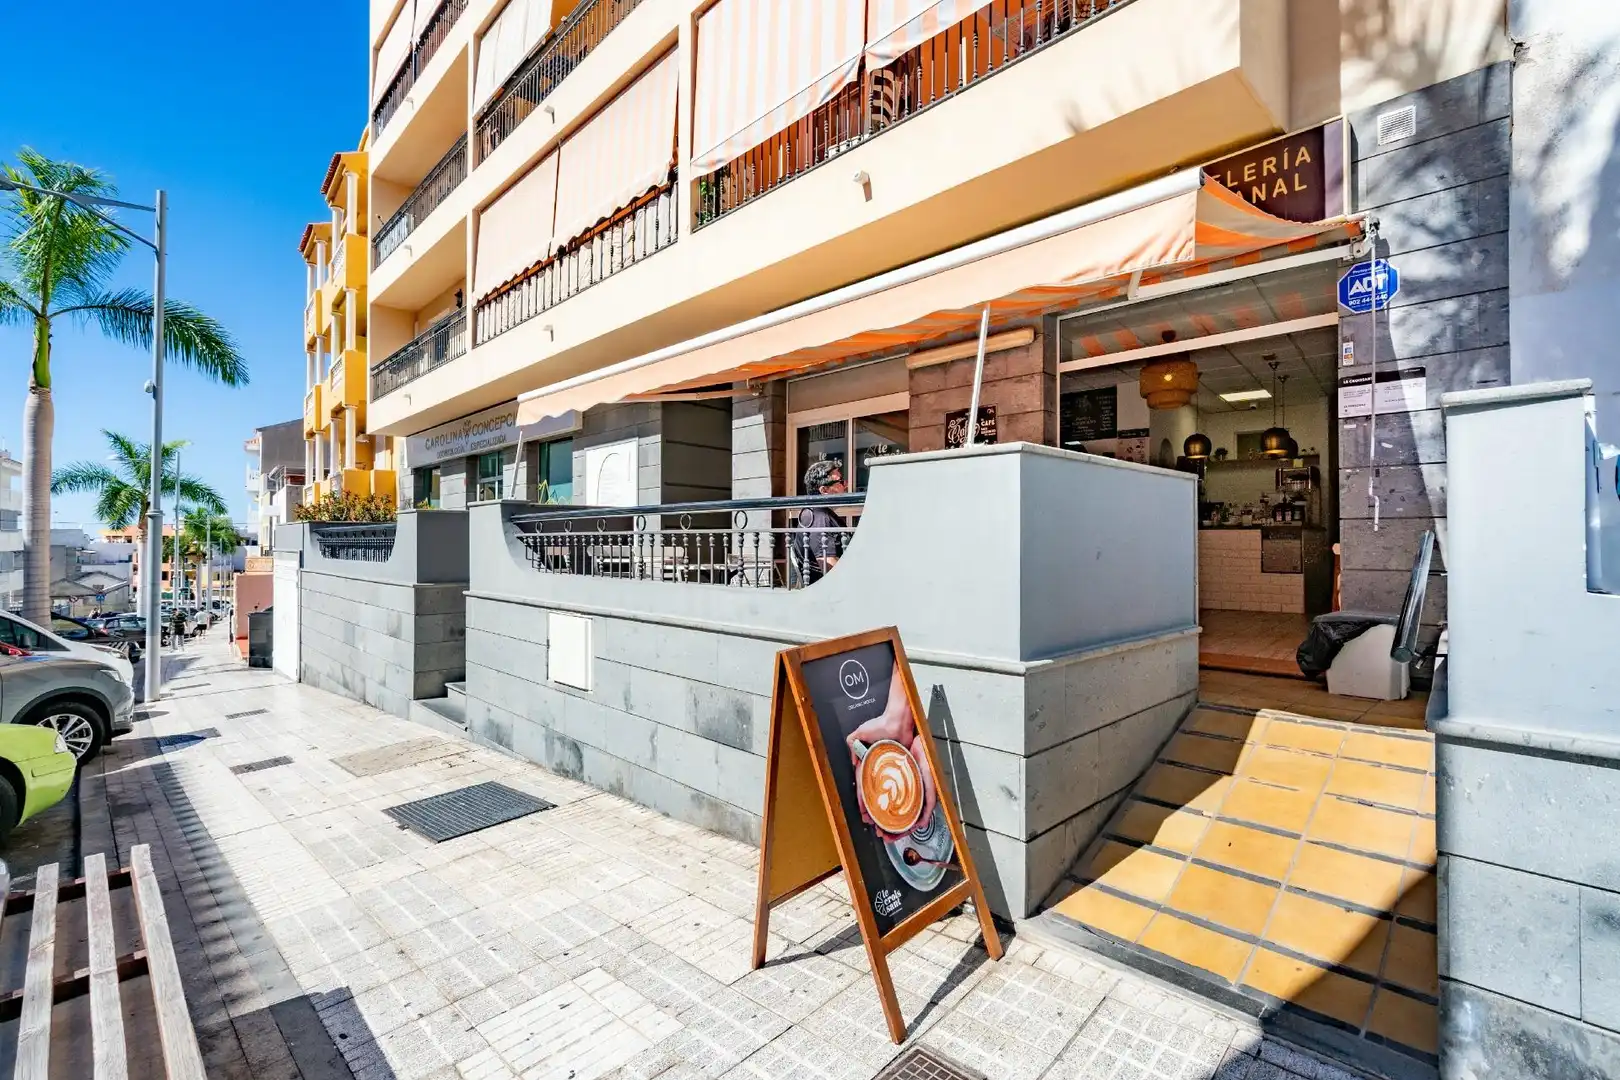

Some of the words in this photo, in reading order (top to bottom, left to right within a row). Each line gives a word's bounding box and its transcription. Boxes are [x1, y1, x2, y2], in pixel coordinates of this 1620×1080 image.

[1348, 273, 1387, 296] ADT
[425, 428, 465, 451] CAROLINA
[471, 412, 518, 436] CONCEPCI
[844, 671, 865, 687] OM
[881, 889, 889, 899] le
[883, 889, 902, 906] crois
[885, 897, 902, 913] sant
